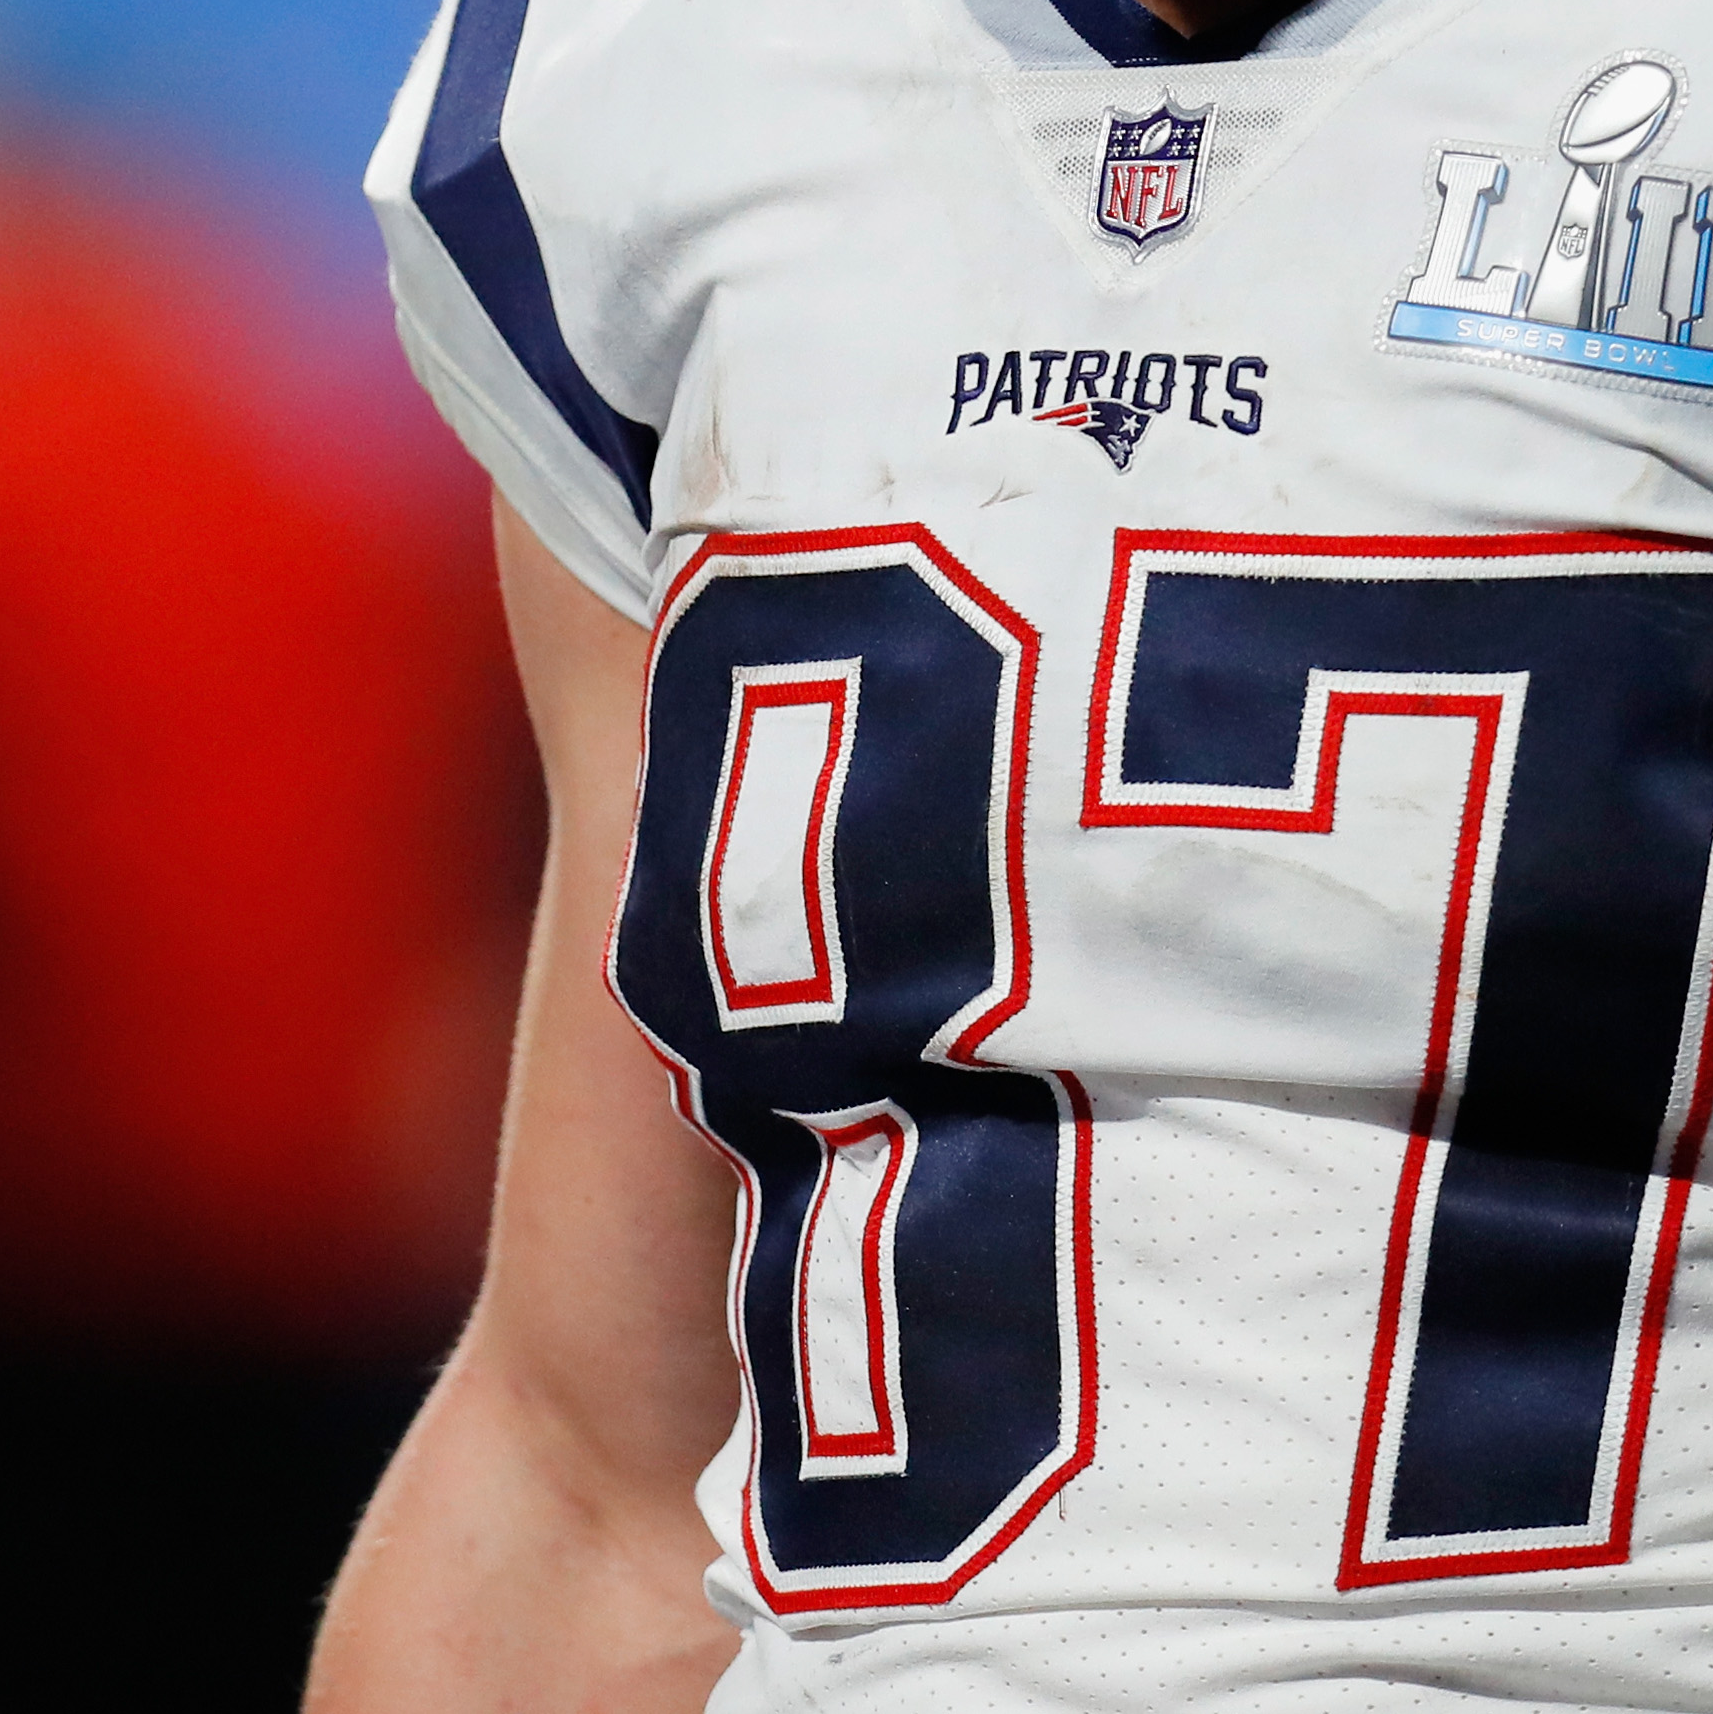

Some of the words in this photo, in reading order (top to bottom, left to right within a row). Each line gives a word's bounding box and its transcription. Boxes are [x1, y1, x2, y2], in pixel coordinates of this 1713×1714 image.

[1105, 164, 1185, 230] NFL
[1559, 237, 1583, 255] NFL
[1455, 318, 1567, 352] SUPER
[1583, 338, 1676, 372] BOWL
[945, 349, 1269, 436] PATRIOTS
